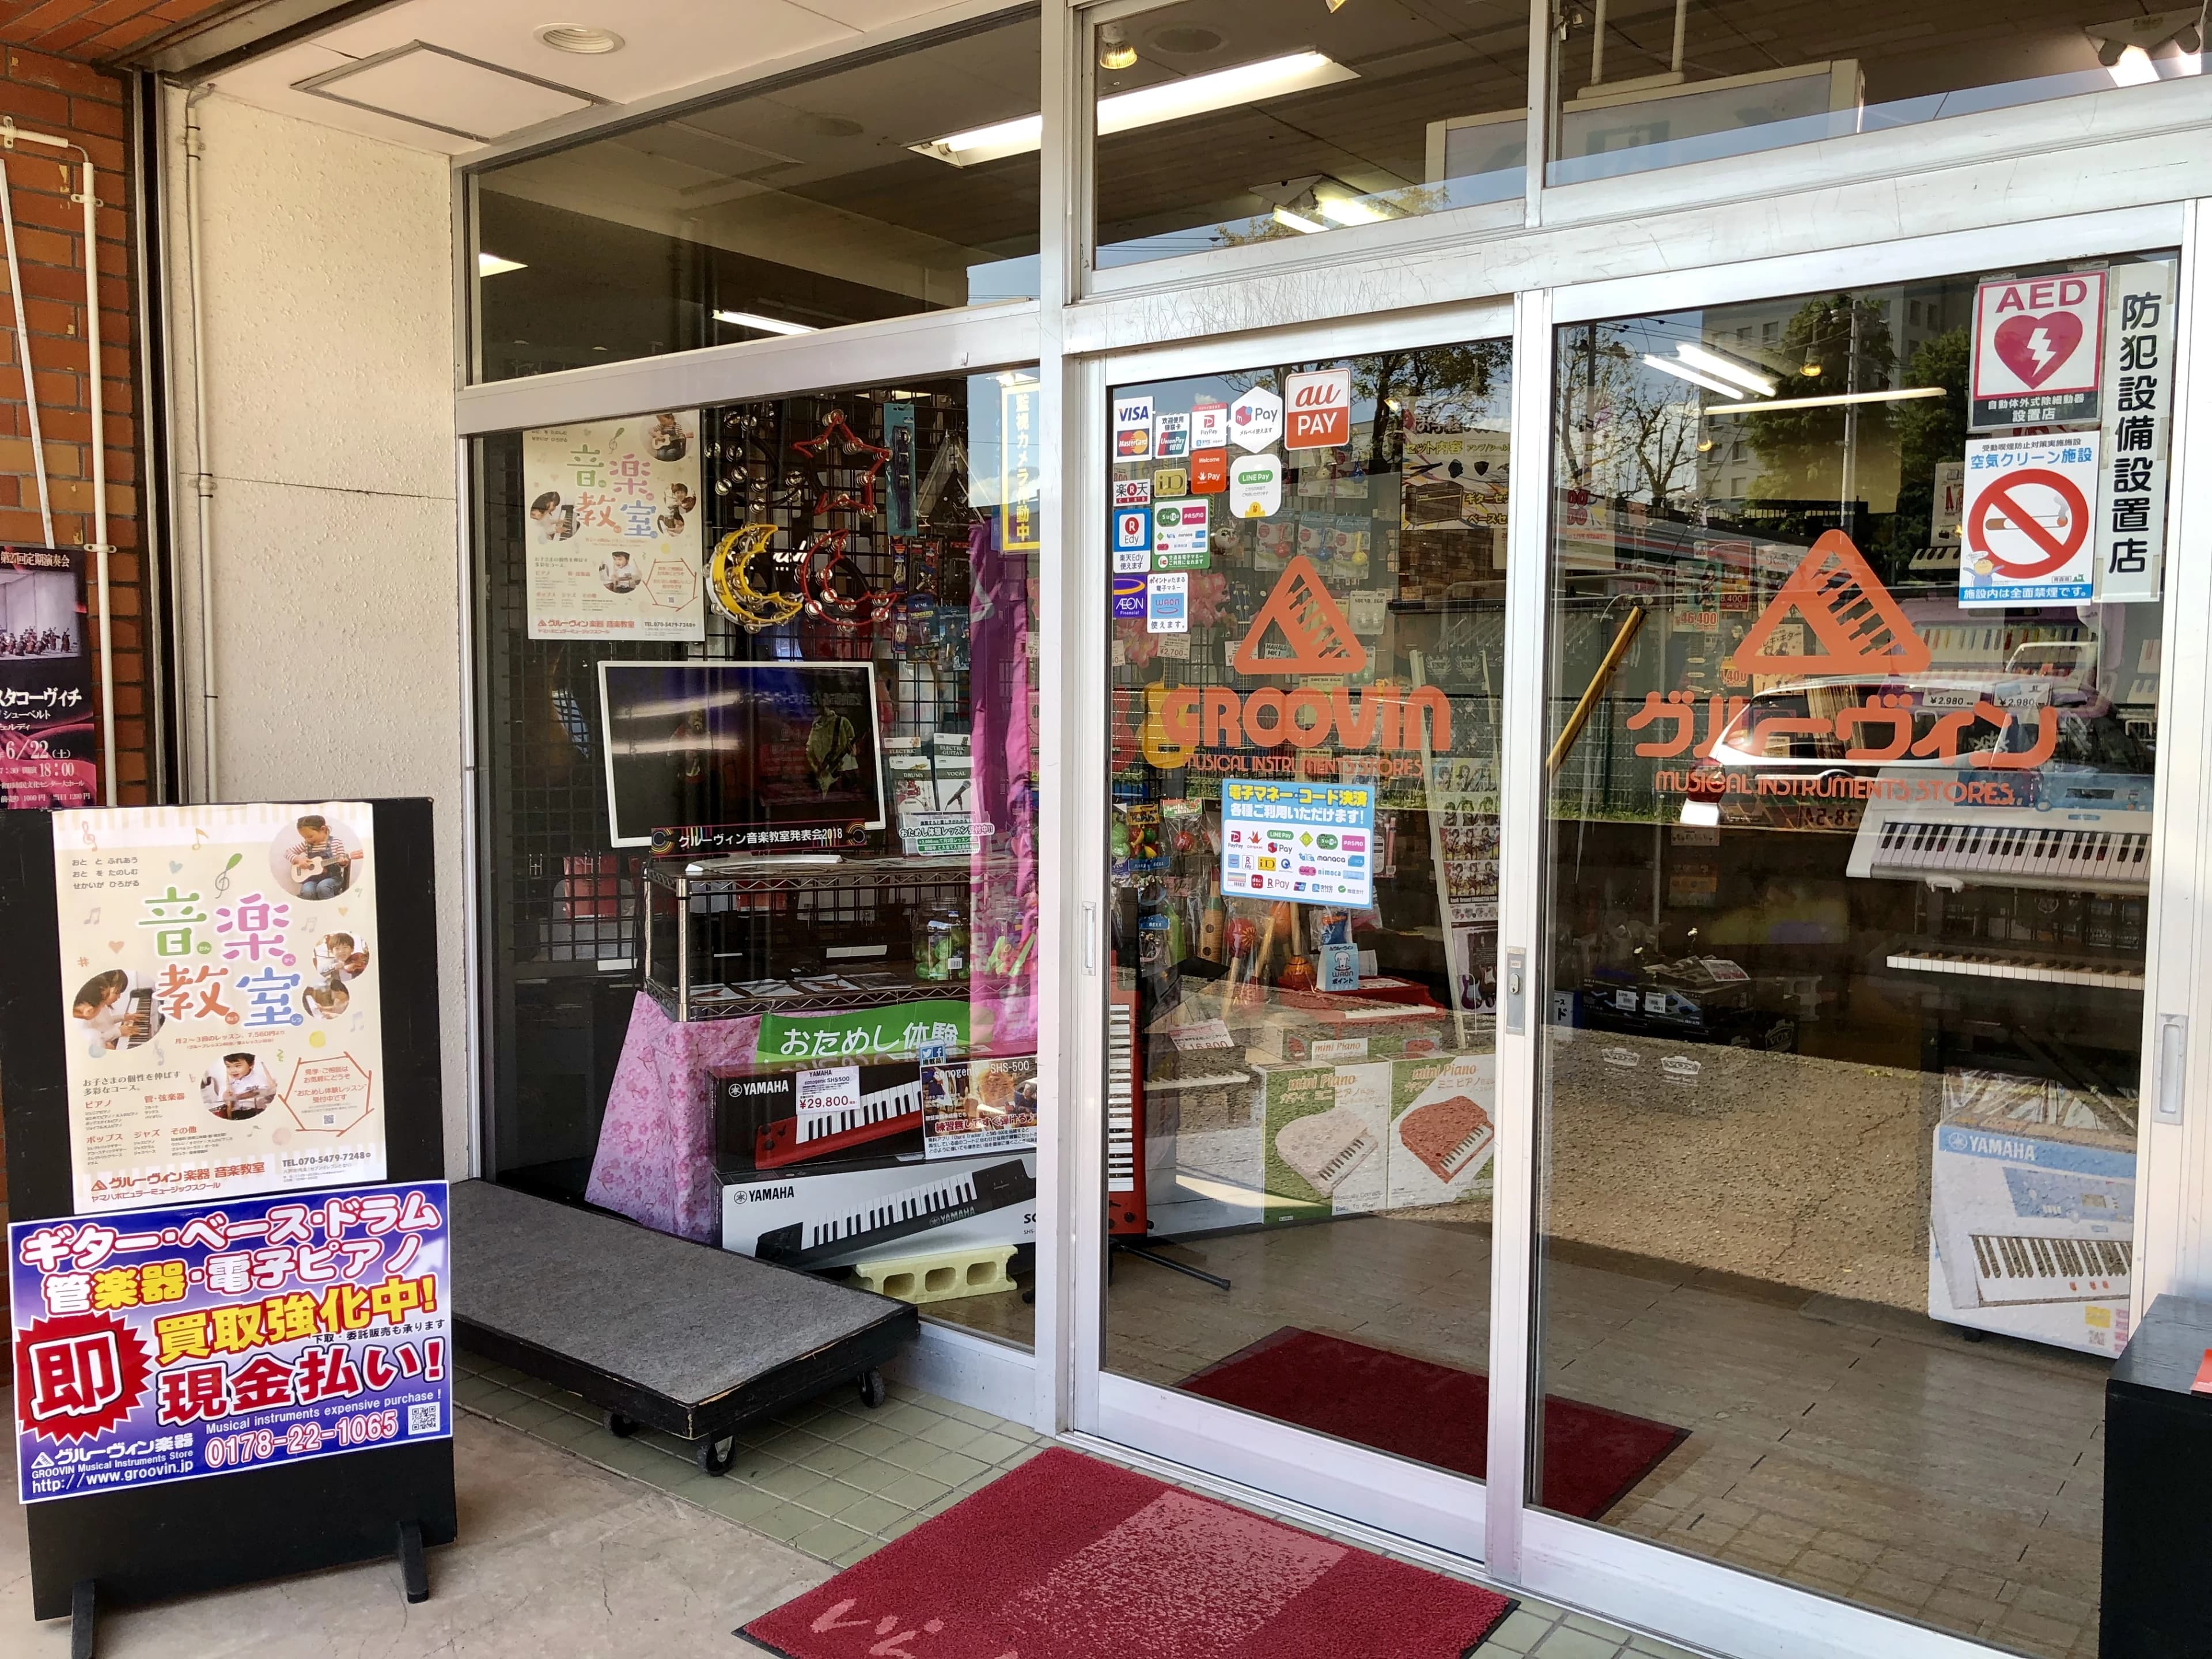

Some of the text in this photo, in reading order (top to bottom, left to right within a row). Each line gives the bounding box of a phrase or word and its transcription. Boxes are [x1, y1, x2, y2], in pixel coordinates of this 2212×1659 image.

[1995, 279, 2088, 313] AED
[1295, 382, 1342, 407] au
[1987, 392, 2085, 410] 自動体外式除細動器
[1118, 406, 1149, 422] VISA
[1255, 407, 1278, 422] Pay
[2012, 407, 2056, 422] 設置店
[1240, 427, 1272, 436] メルペイ使えます
[1297, 412, 1339, 436] PAY
[2108, 290, 2162, 574] 防犯設備設置店
[1119, 439, 1147, 448] MasterCard
[1161, 437, 1184, 445] UnionPay
[1405, 441, 1463, 454] セット内容
[1982, 437, 2081, 452] 受動喫煙防止対策実施施設
[1970, 446, 2093, 470] 空気クリーン施設
[567, 444, 651, 495] 音楽
[1207, 472, 1220, 481] Pay
[1257, 473, 1270, 481] Pay
[1158, 475, 1183, 490] iD
[576, 491, 657, 537] 教室
[1125, 535, 1139, 545] Edy
[1120, 554, 1143, 562] 楽天Edy
[1120, 562, 1143, 570] 使えます
[1963, 586, 2086, 599] 施設内は全面禁煙です。
[1152, 620, 1184, 629] 使えます。
[1160, 648, 1183, 656] ¥2,700
[1930, 697, 1964, 705] ¥2,980
[1999, 698, 2035, 707] ¥2,980
[3, 709, 51, 719] シューベルト
[1162, 685, 1450, 751] GROOVIN
[1626, 690, 2058, 769] グルーヴィン
[6, 740, 49, 760] 6/22
[1184, 754, 1422, 777] MUSICAL INSTRUMENTS STORES
[1228, 783, 1368, 807] 電子マネー・コード決済
[1656, 770, 2014, 805] MUSICAL INSTRUMENTS STORES
[679, 828, 843, 849] グルーヴィン音楽教室発表会2018
[1279, 844, 1293, 854] Pay
[1260, 859, 1275, 869] iD
[1318, 868, 1341, 876] nimoca
[73, 881, 104, 889] せかいが
[1275, 879, 1290, 889] Pay
[139, 887, 290, 960] 音楽
[153, 964, 300, 1027] 教室
[291, 1016, 302, 1024] しつ
[780, 1021, 959, 1056] おためし体験
[1314, 1042, 1361, 1052] mini Piano
[990, 1060, 1029, 1073] SHS-500
[1412, 1064, 1477, 1080] mini Piano
[1671, 1062, 1694, 1070] VOX
[83, 1071, 180, 1086] お子さまの個性を伸ばす
[304, 1074, 350, 1083] お気軽にどうぞ
[1288, 1074, 1355, 1091] mini Piano
[1438, 1079, 1453, 1089] ミニ
[1456, 1078, 1480, 1087] ピアノ
[84, 1085, 141, 1096] 多彩なコース。
[743, 1080, 789, 1097] YAMAHA
[85, 1092, 185, 1109] ピアノ 管・弦楽器
[313, 1094, 347, 1103] 受付中です
[800, 1096, 849, 1109] ¥29,800
[1280, 1093, 1306, 1104] カワイ
[1314, 1090, 1332, 1101] ミニ
[86, 1133, 123, 1143] ポップス
[134, 1129, 160, 1138] ジャズ
[171, 1126, 196, 1135] その他
[1969, 1135, 2036, 1161] YAMAHA
[109, 1168, 210, 1189] グルーヴィン楽器
[214, 1162, 265, 1179] 音楽教室
[92, 1182, 221, 1203] ヤマハポピュラーミュージックスクール
[748, 1185, 795, 1203] YAMAHA
[940, 1206, 976, 1222] YAMAHA
[21, 1191, 441, 1272] ギター・ベース・ドラム
[44, 1234, 422, 1315] 管楽器・電子ピアノ
[153, 1274, 437, 1365] 買取強化中!
[312, 1319, 446, 1344] 下取・委託販売も承ります
[29, 1331, 124, 1420] 即
[157, 1336, 446, 1427] 現金払い!
[206, 1418, 249, 1435] Musical
[253, 1407, 320, 1427] instruments
[323, 1398, 380, 1419] expensive
[204, 1410, 399, 1468] 0178-22-1065
[54, 1432, 194, 1465] グルーヴィン楽器
[32, 1449, 194, 1480] GROOVIN Musical Instruments Store
[32, 1460, 194, 1494] http://www.groovin.jp
